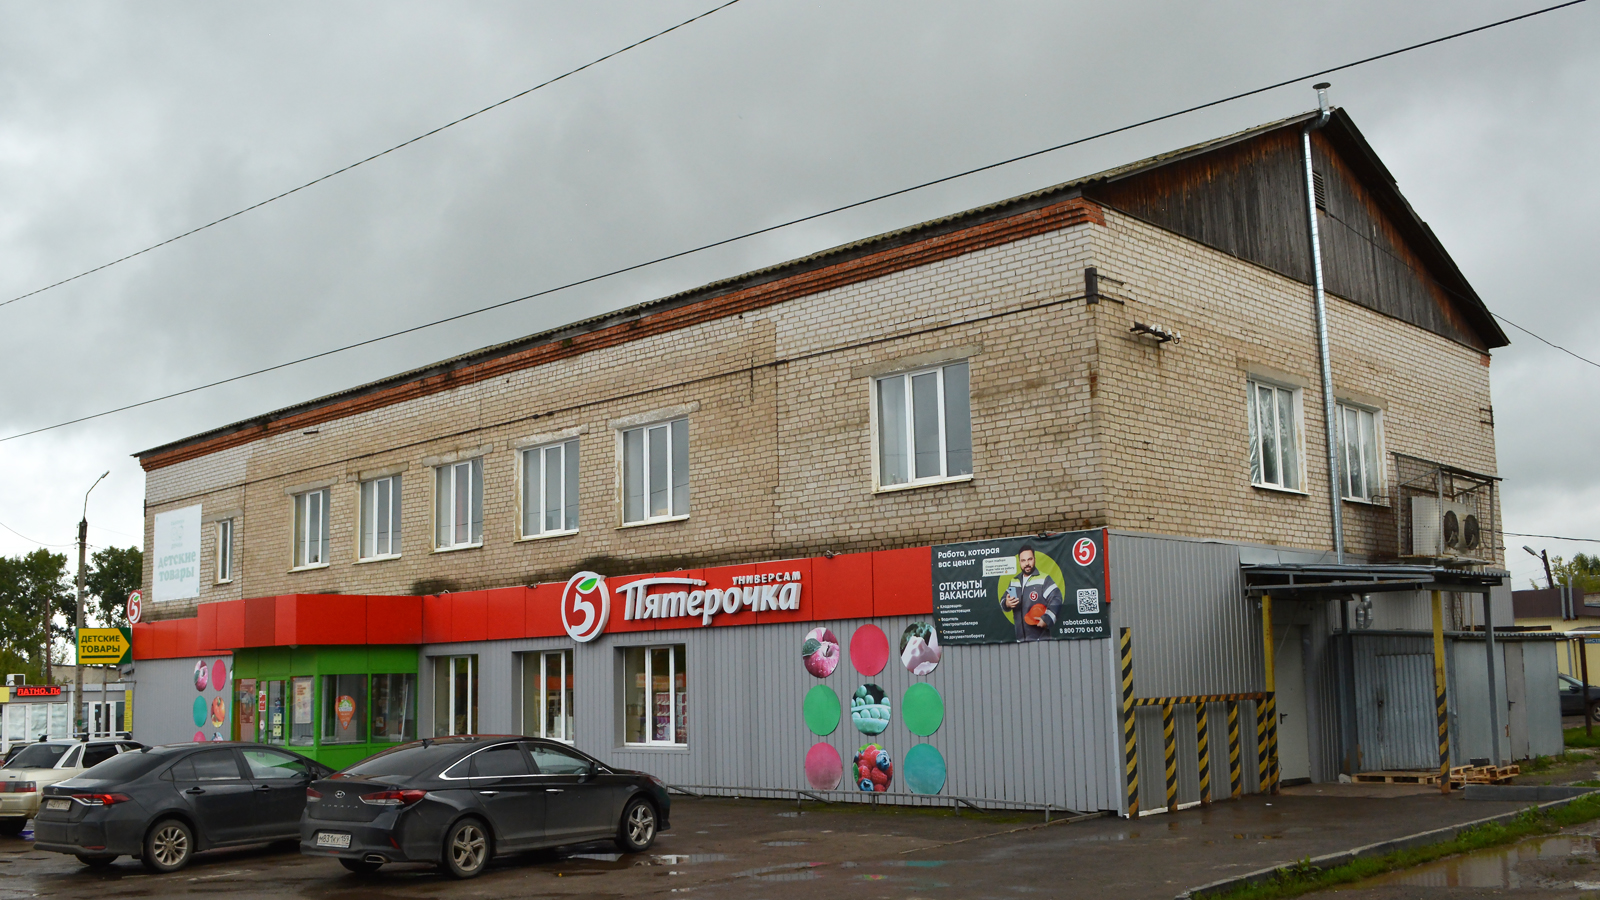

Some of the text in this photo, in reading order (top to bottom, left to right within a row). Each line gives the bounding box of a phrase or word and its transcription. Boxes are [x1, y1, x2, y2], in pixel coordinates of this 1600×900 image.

[938, 547, 1000, 559] Работа, которая
[158, 551, 197, 569] детские
[938, 559, 976, 568] вас ценит
[159, 566, 194, 583] товары
[732, 571, 802, 585] УНИВЕРСАМ
[939, 580, 983, 591] ОТКРЫТЫ
[939, 589, 987, 601] ВАКАНСИИ
[616, 577, 803, 626] Пятерочка
[1062, 618, 1102, 626] rabota5ka.ru
[81, 635, 121, 643] ДЕТСКИЕ
[81, 645, 121, 653] ТОВАРЫ
